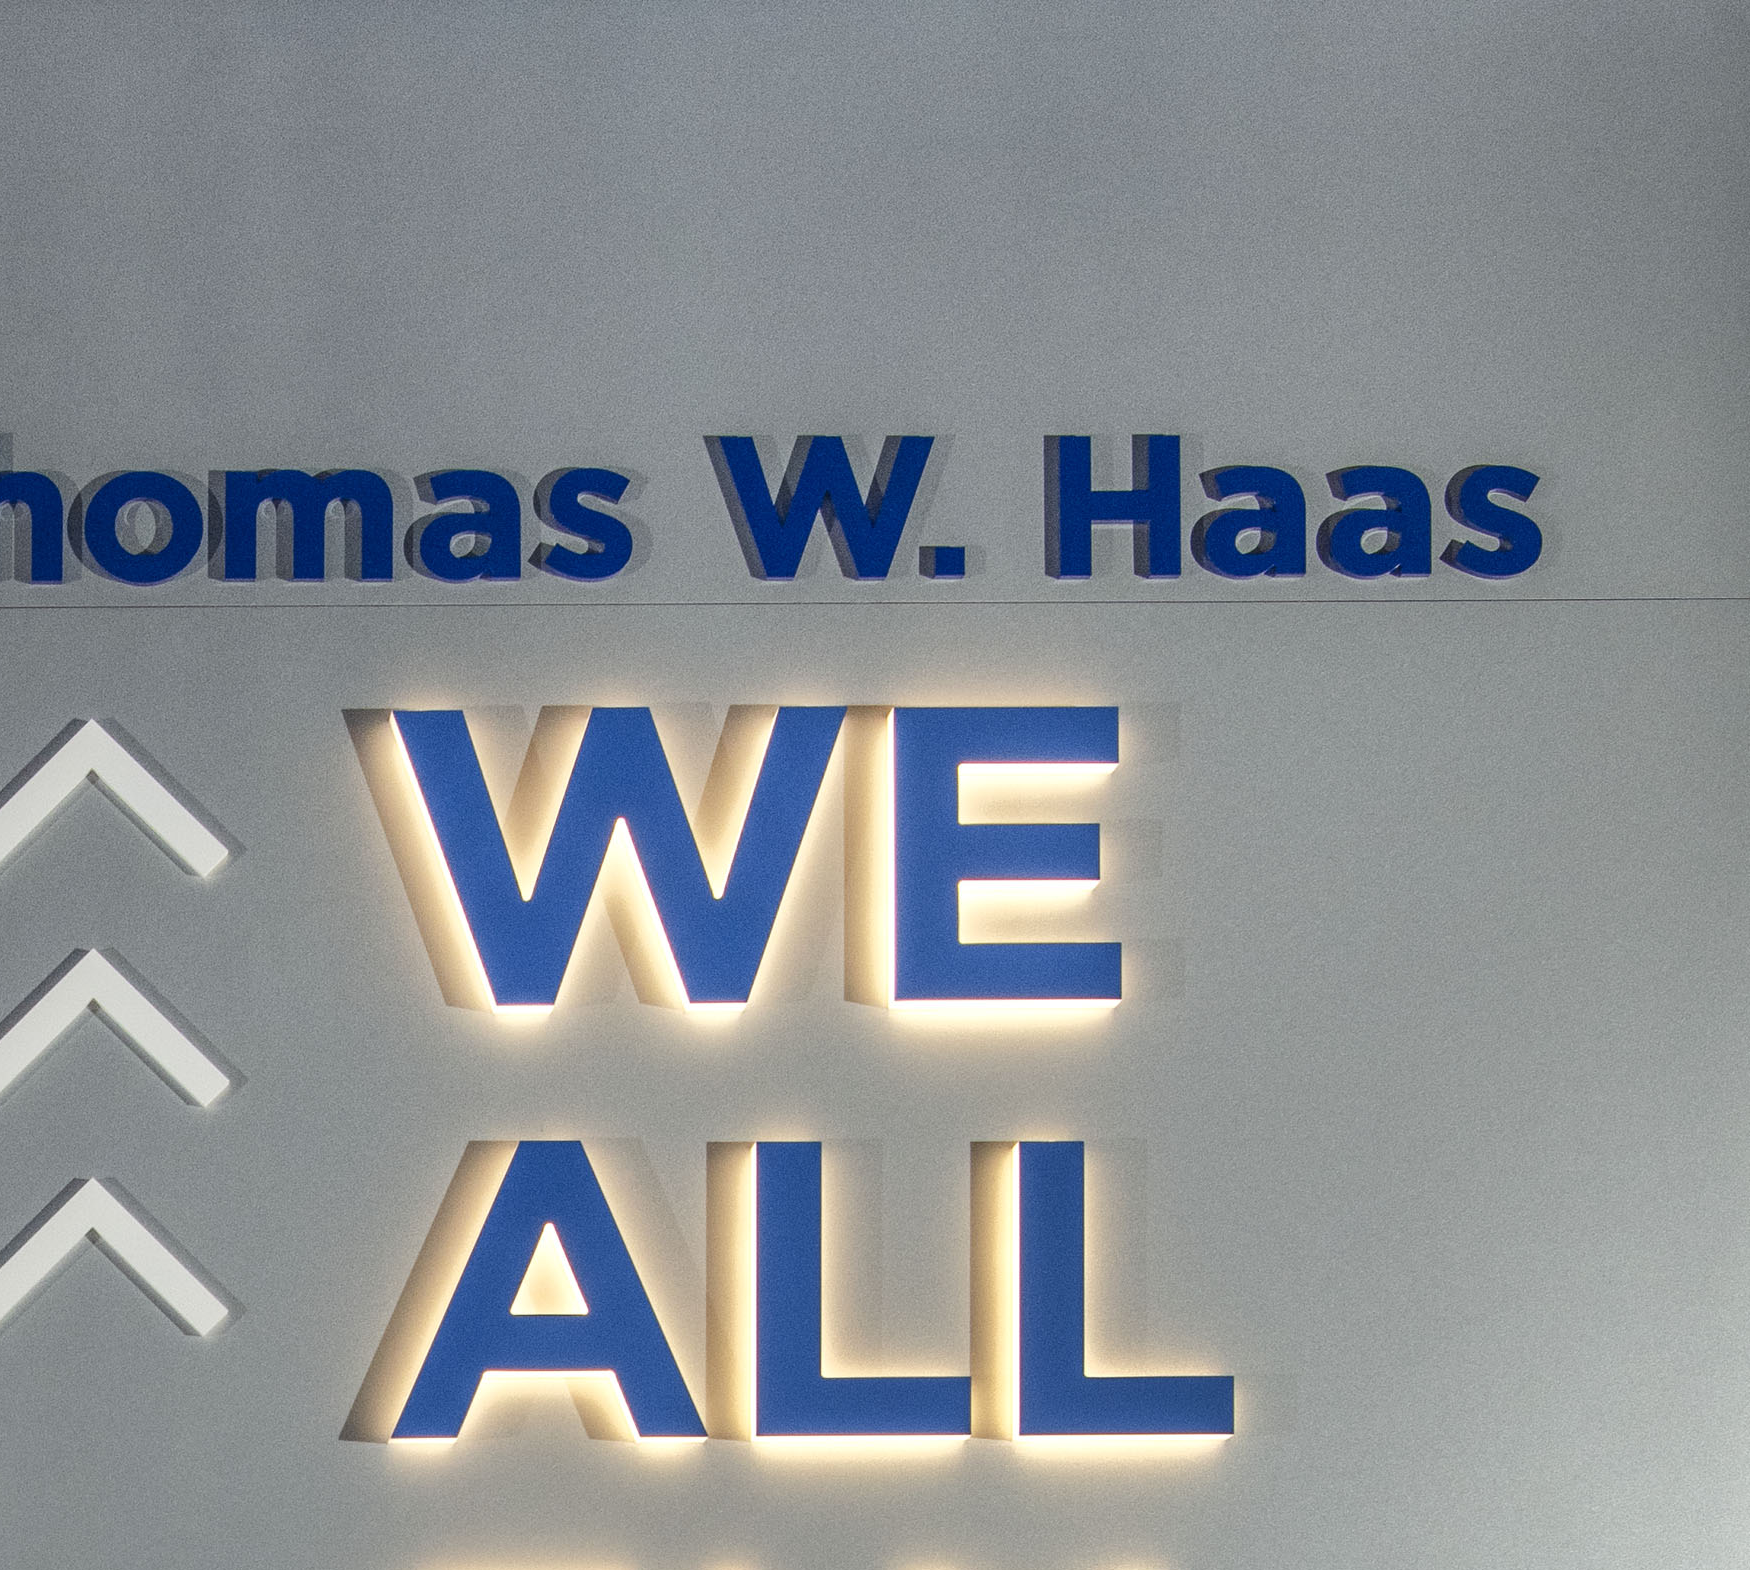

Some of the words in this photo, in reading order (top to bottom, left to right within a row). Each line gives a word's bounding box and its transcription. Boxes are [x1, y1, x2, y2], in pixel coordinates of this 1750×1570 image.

[720, 436, 964, 577] W.
[1059, 435, 1541, 576] Haas
[391, 706, 1122, 1004] WE
[390, 1141, 1234, 1438] ALL
